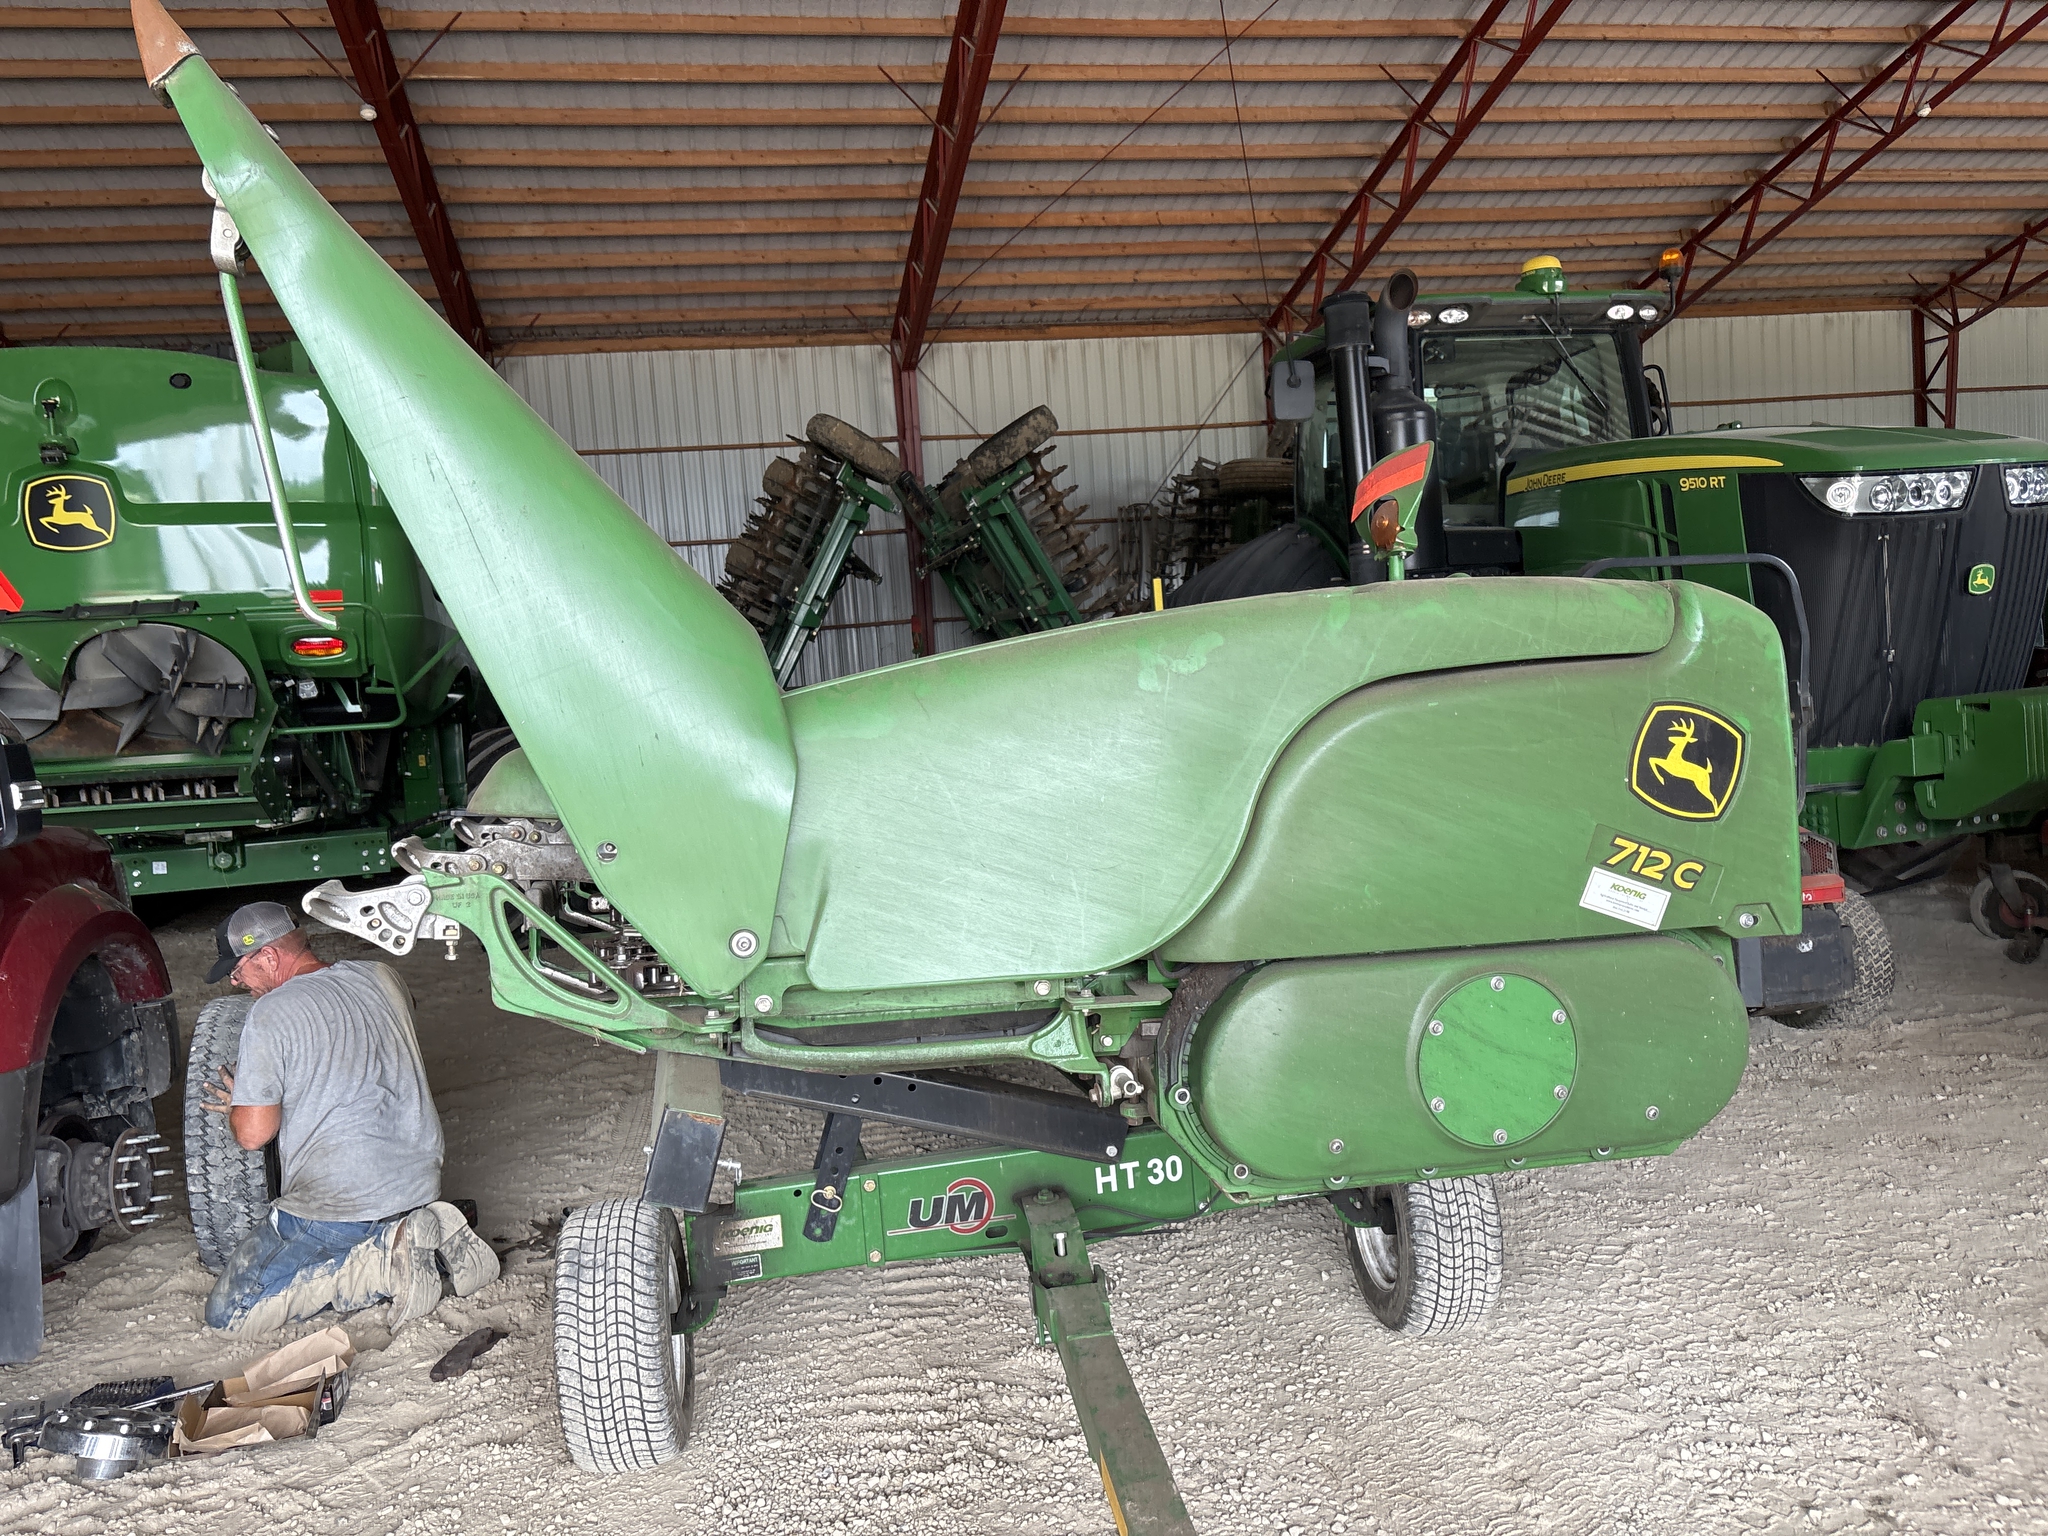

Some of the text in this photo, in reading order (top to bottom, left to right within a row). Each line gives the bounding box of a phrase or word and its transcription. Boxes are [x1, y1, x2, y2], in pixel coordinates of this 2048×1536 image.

[1524, 472, 1566, 492] JOHN DEERE
[1679, 475, 1726, 491] 9510 RT
[1602, 834, 1673, 884] 712
[1095, 1154, 1184, 1195] HT 30
[907, 1190, 987, 1229] UM
